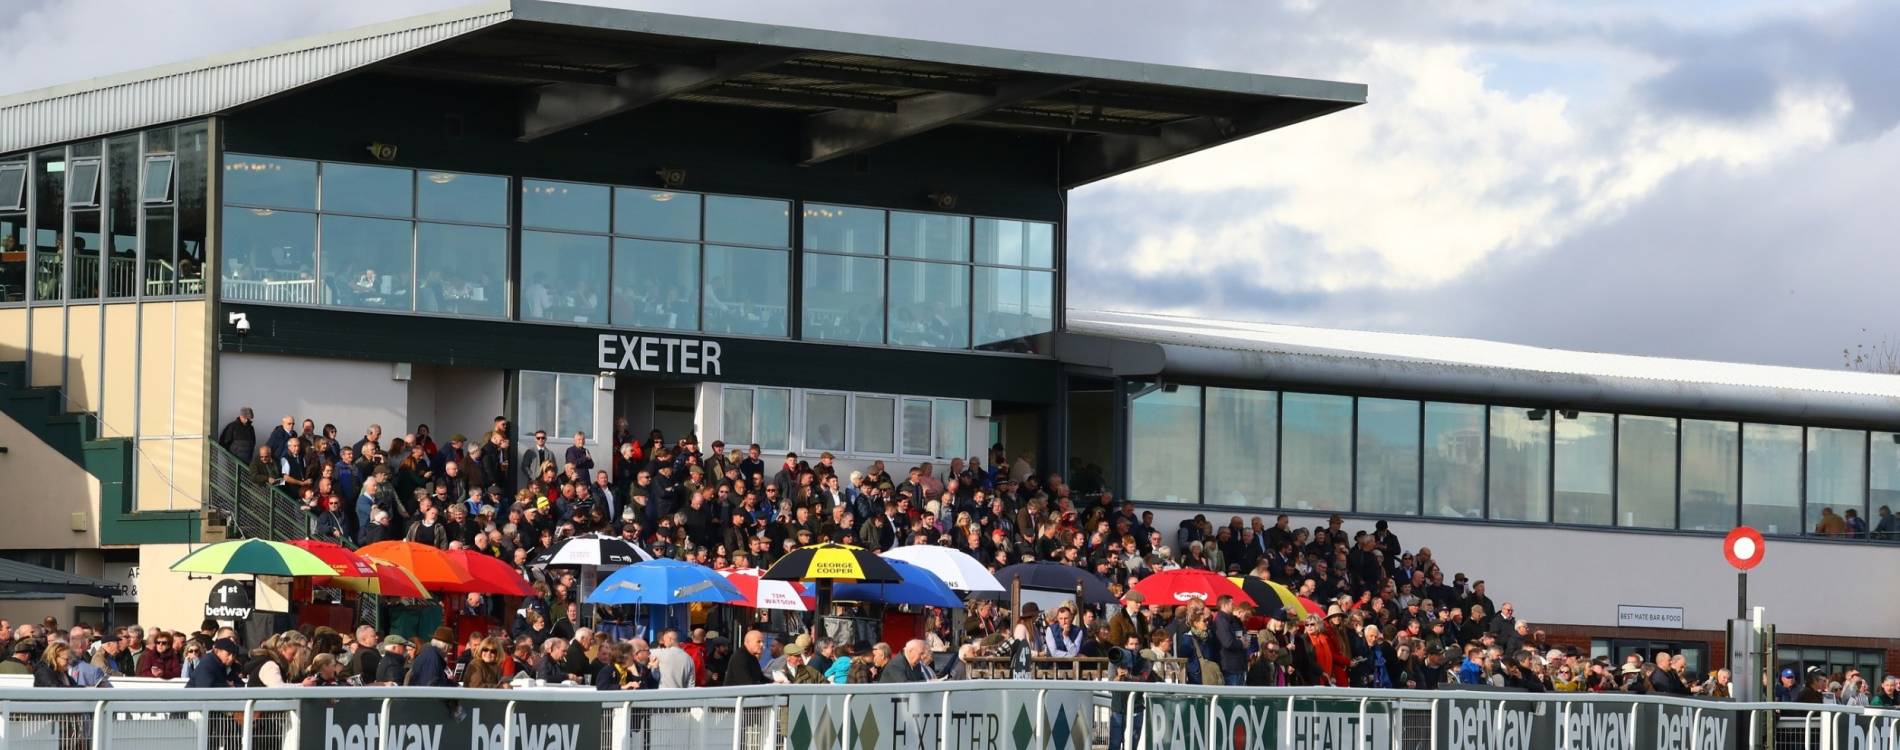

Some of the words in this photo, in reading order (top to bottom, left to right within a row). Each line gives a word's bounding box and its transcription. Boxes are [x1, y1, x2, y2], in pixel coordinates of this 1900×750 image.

[598, 334, 721, 375] EXETER
[205, 605, 251, 619] betway
[217, 585, 238, 603] 1st
[1620, 612, 1633, 620] BEST
[1634, 613, 1648, 621] MATE
[1666, 614, 1681, 622] FOOD
[325, 707, 443, 750] betway
[471, 707, 580, 750] betway
[1152, 704, 1269, 750] RANDOX
[1448, 698, 1533, 750] betway
[1555, 702, 1633, 750] betway
[1657, 704, 1728, 750] betway
[1848, 713, 1900, 750] bet
